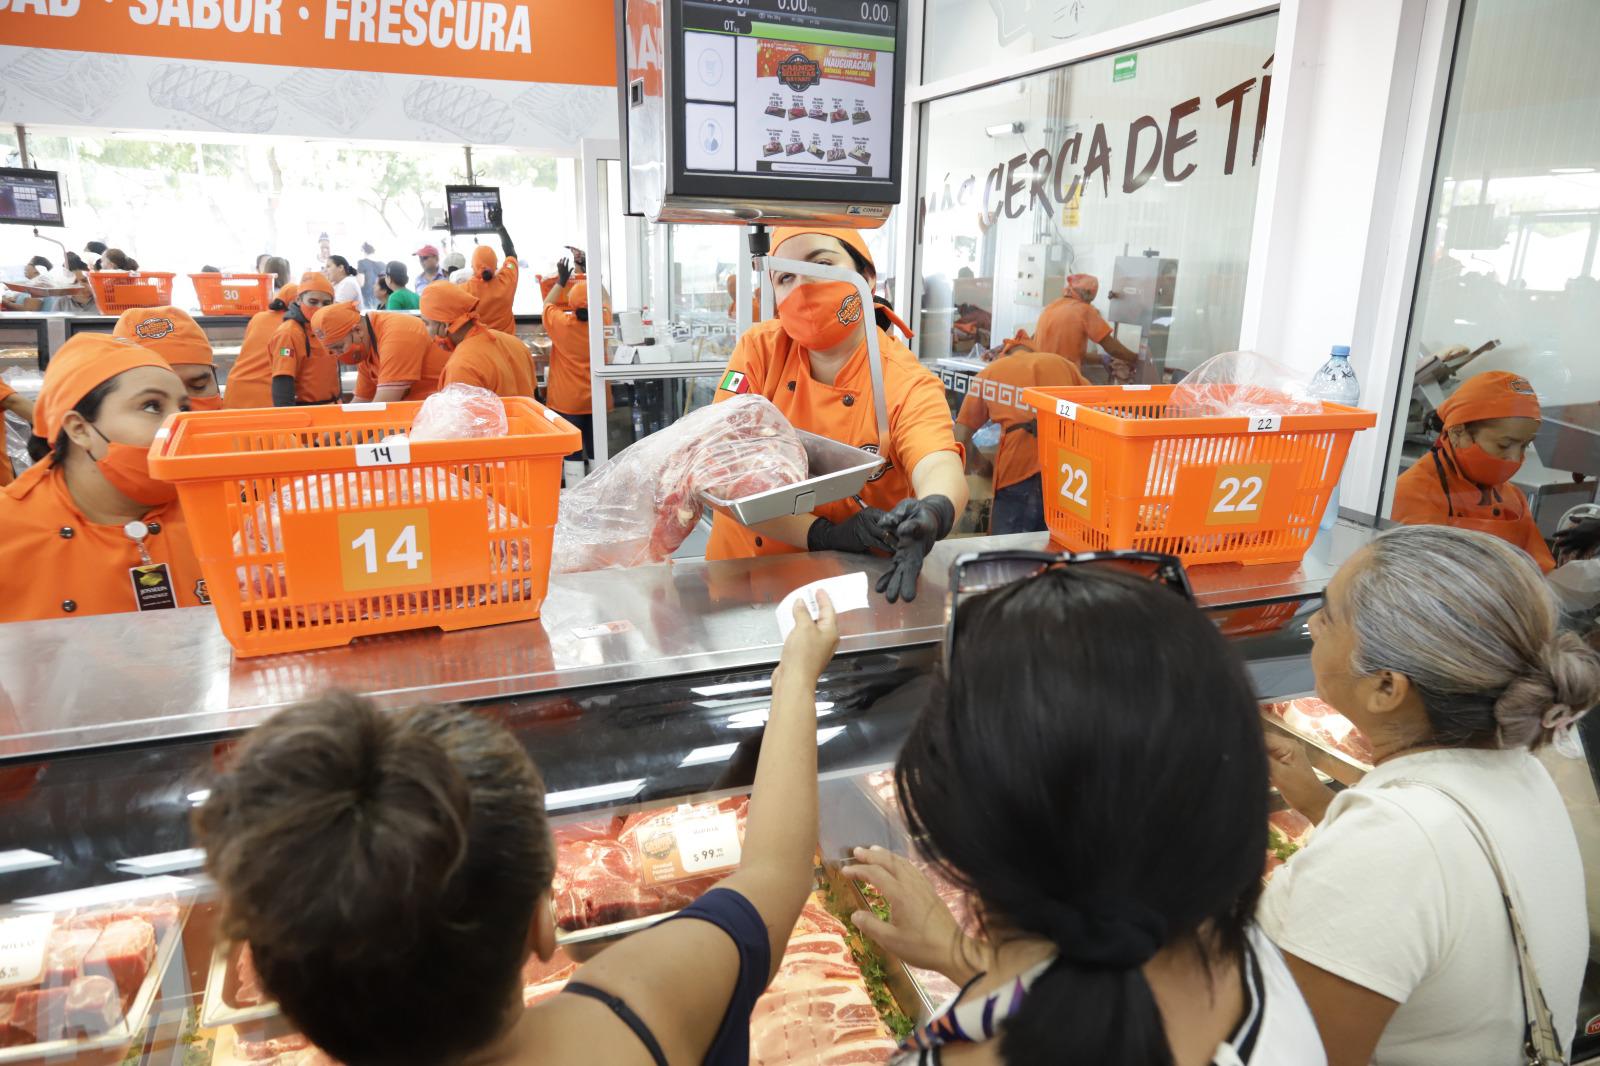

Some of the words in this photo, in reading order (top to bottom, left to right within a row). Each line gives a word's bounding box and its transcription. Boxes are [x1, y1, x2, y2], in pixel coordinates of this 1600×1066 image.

[128, 0, 282, 35] SABOR
[324, 0, 532, 54] FRESCURA
[983, 122, 1112, 228] CERCA
[1123, 96, 1200, 193] DE
[1216, 53, 1275, 176] TÍ
[223, 289, 239, 300] 30
[1257, 418, 1272, 430] 22
[370, 446, 392, 463] 14
[1061, 463, 1088, 507] 22
[1213, 476, 1263, 513] 22
[351, 525, 424, 574] 14
